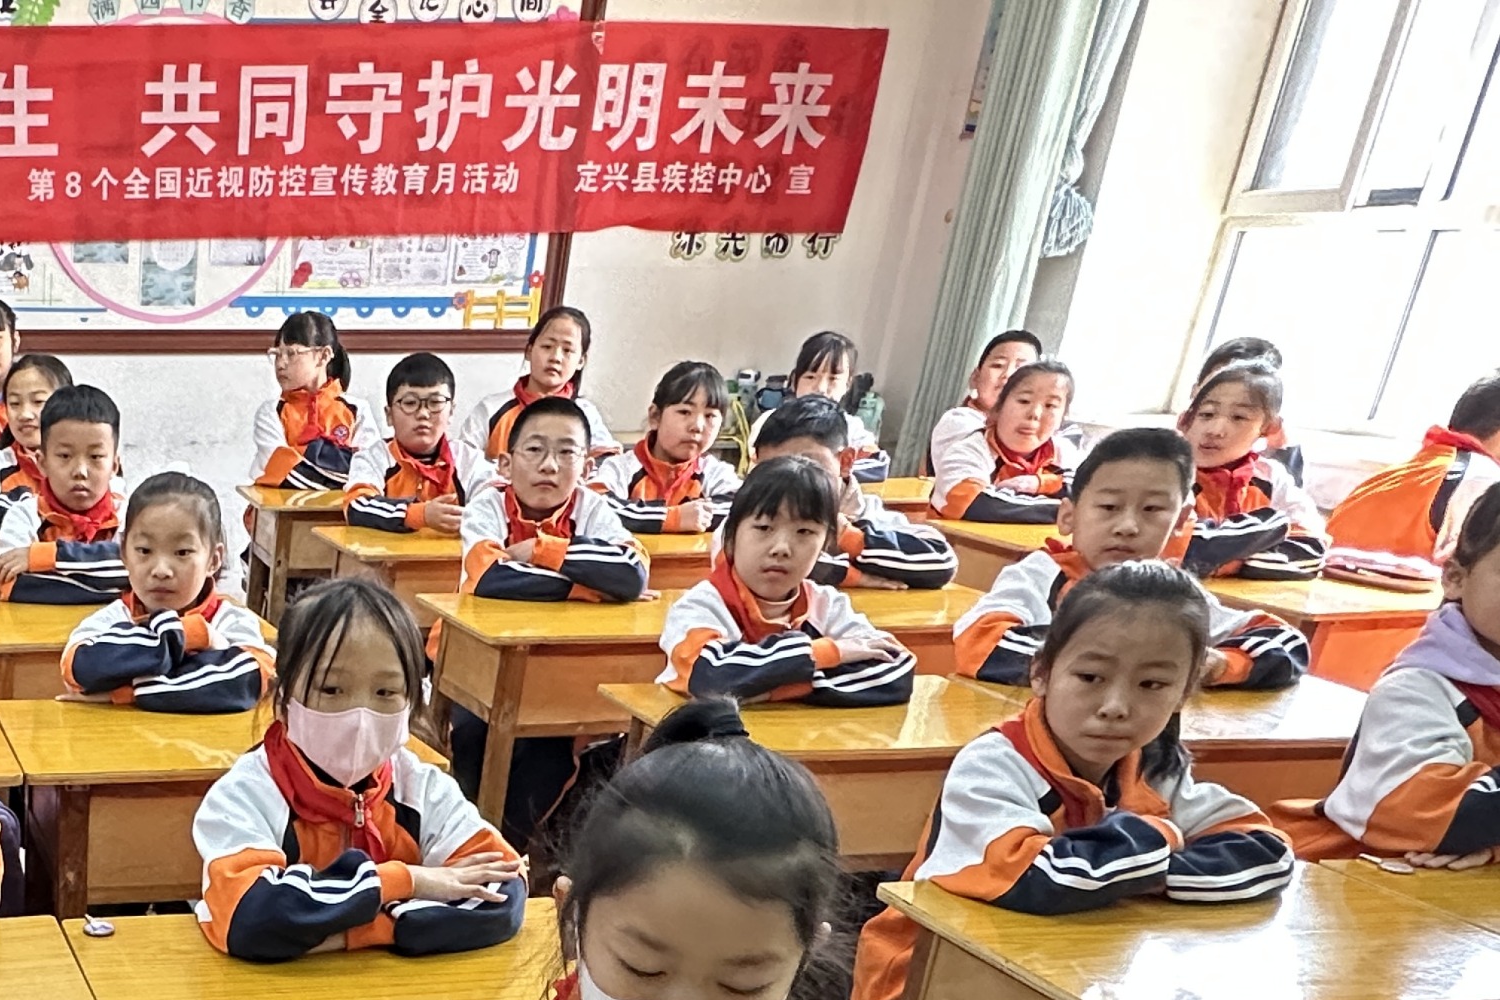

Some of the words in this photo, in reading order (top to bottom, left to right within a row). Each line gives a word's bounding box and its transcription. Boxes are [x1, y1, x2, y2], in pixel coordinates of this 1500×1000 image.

[140, 60, 833, 157] 共同守护光明未来
[27, 161, 519, 202] 第8个全国近视防控宣传教育月活动
[574, 161, 771, 194] 定兴县疾控中心
[785, 164, 814, 194] 宣
